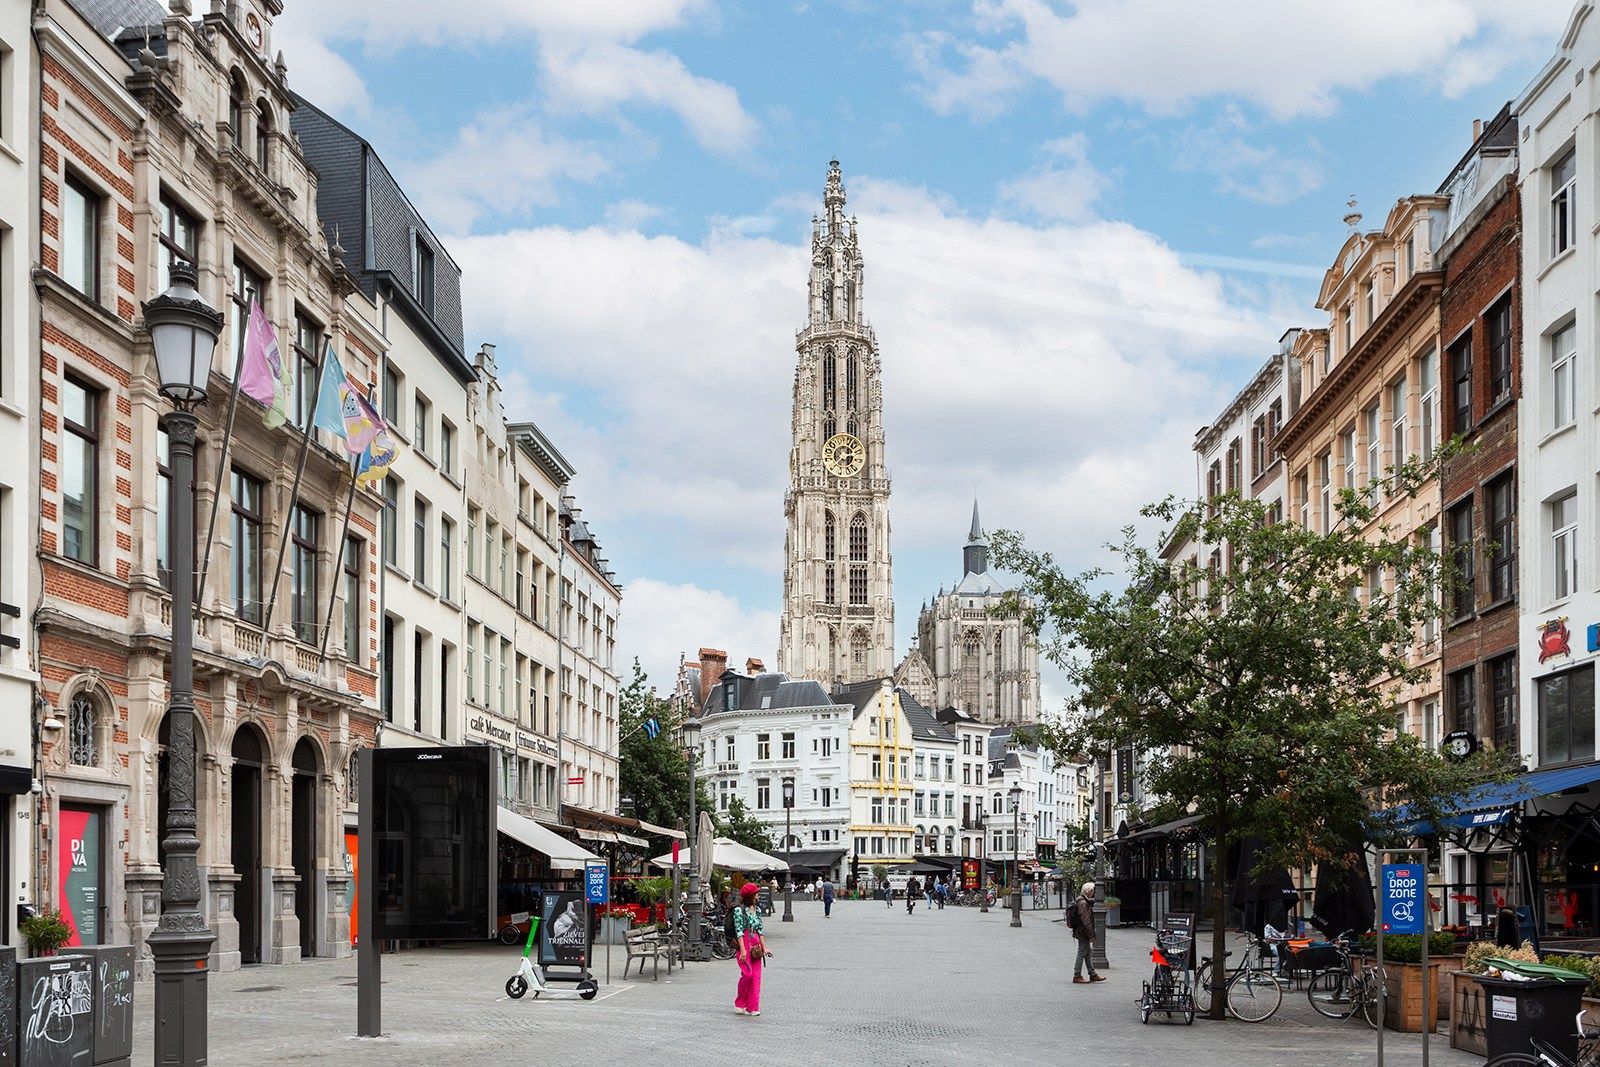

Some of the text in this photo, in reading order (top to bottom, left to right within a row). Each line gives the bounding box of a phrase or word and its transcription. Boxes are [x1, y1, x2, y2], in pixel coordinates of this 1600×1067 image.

[471, 716, 512, 743] café Mercator
[519, 732, 536, 750] frituur
[70, 839, 84, 852] DI
[71, 853, 87, 866] VA
[1389, 879, 1417, 888] DROP
[1389, 889, 1417, 898] ZONE
